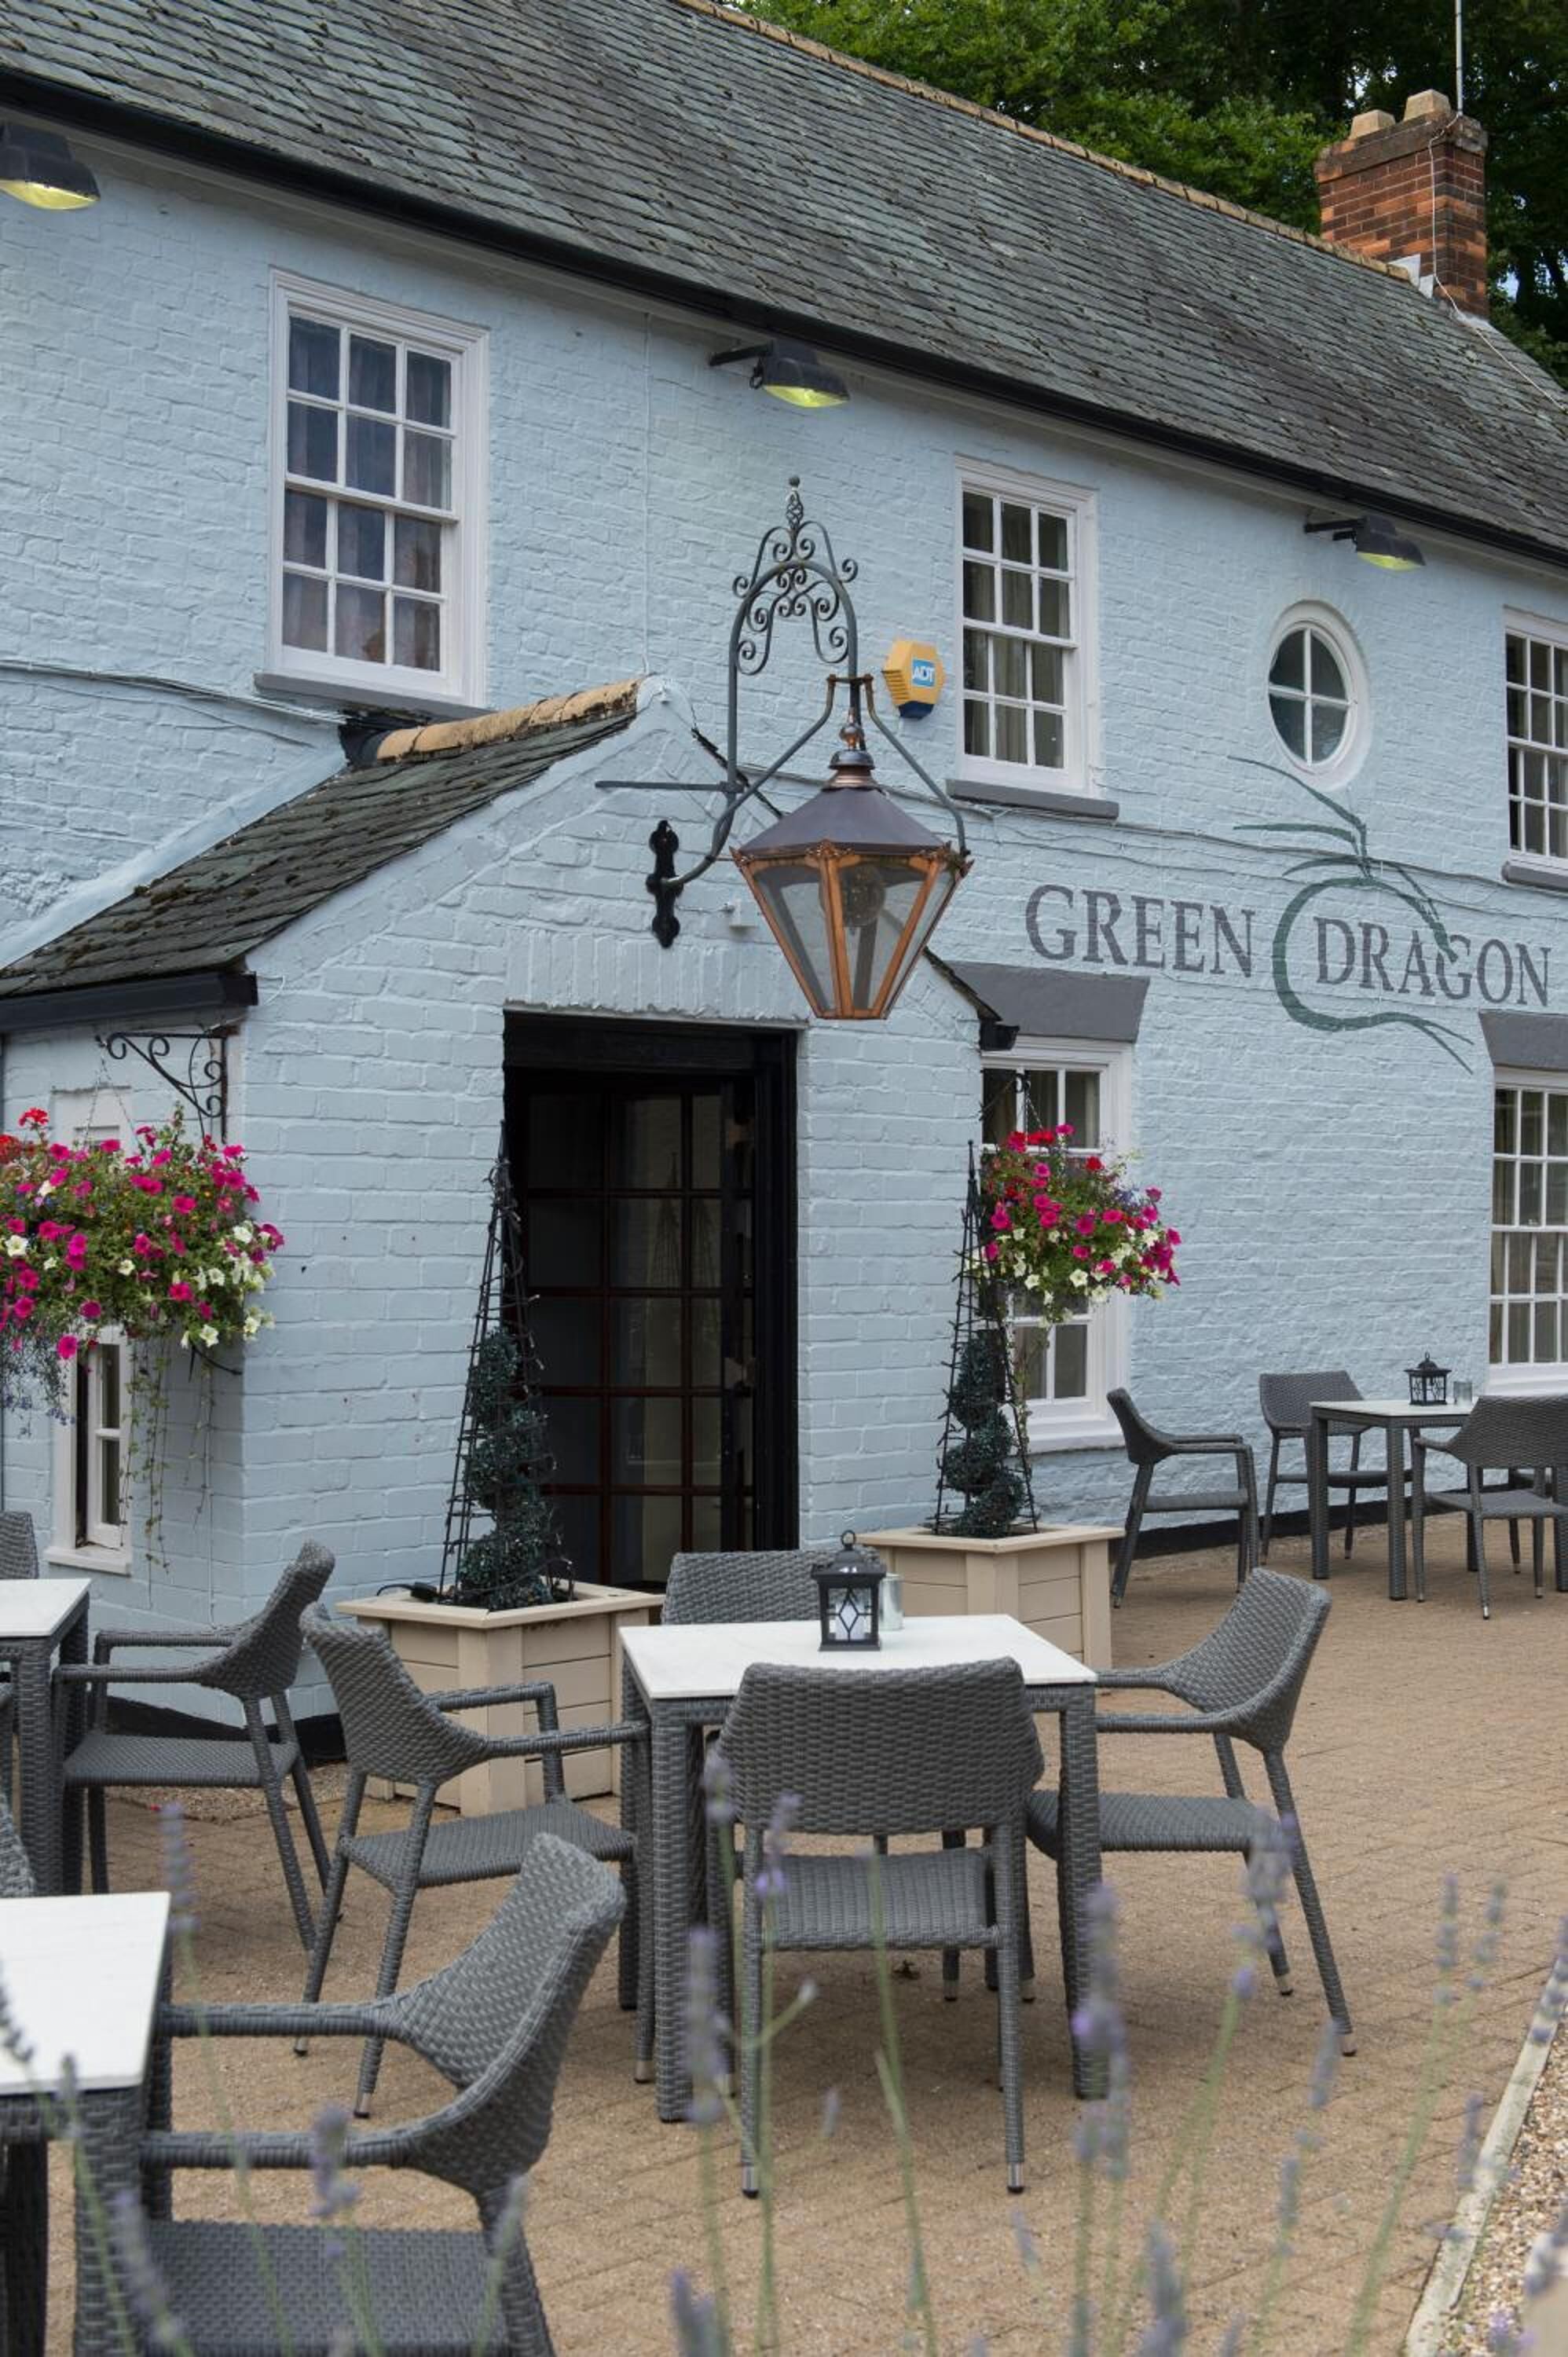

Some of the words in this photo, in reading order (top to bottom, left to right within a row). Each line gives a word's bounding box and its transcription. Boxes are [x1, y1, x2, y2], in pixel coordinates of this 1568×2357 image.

[912, 665, 935, 684] ADT
[1024, 884, 1258, 978] GREEN
[1313, 915, 1552, 1006] DRAGON
